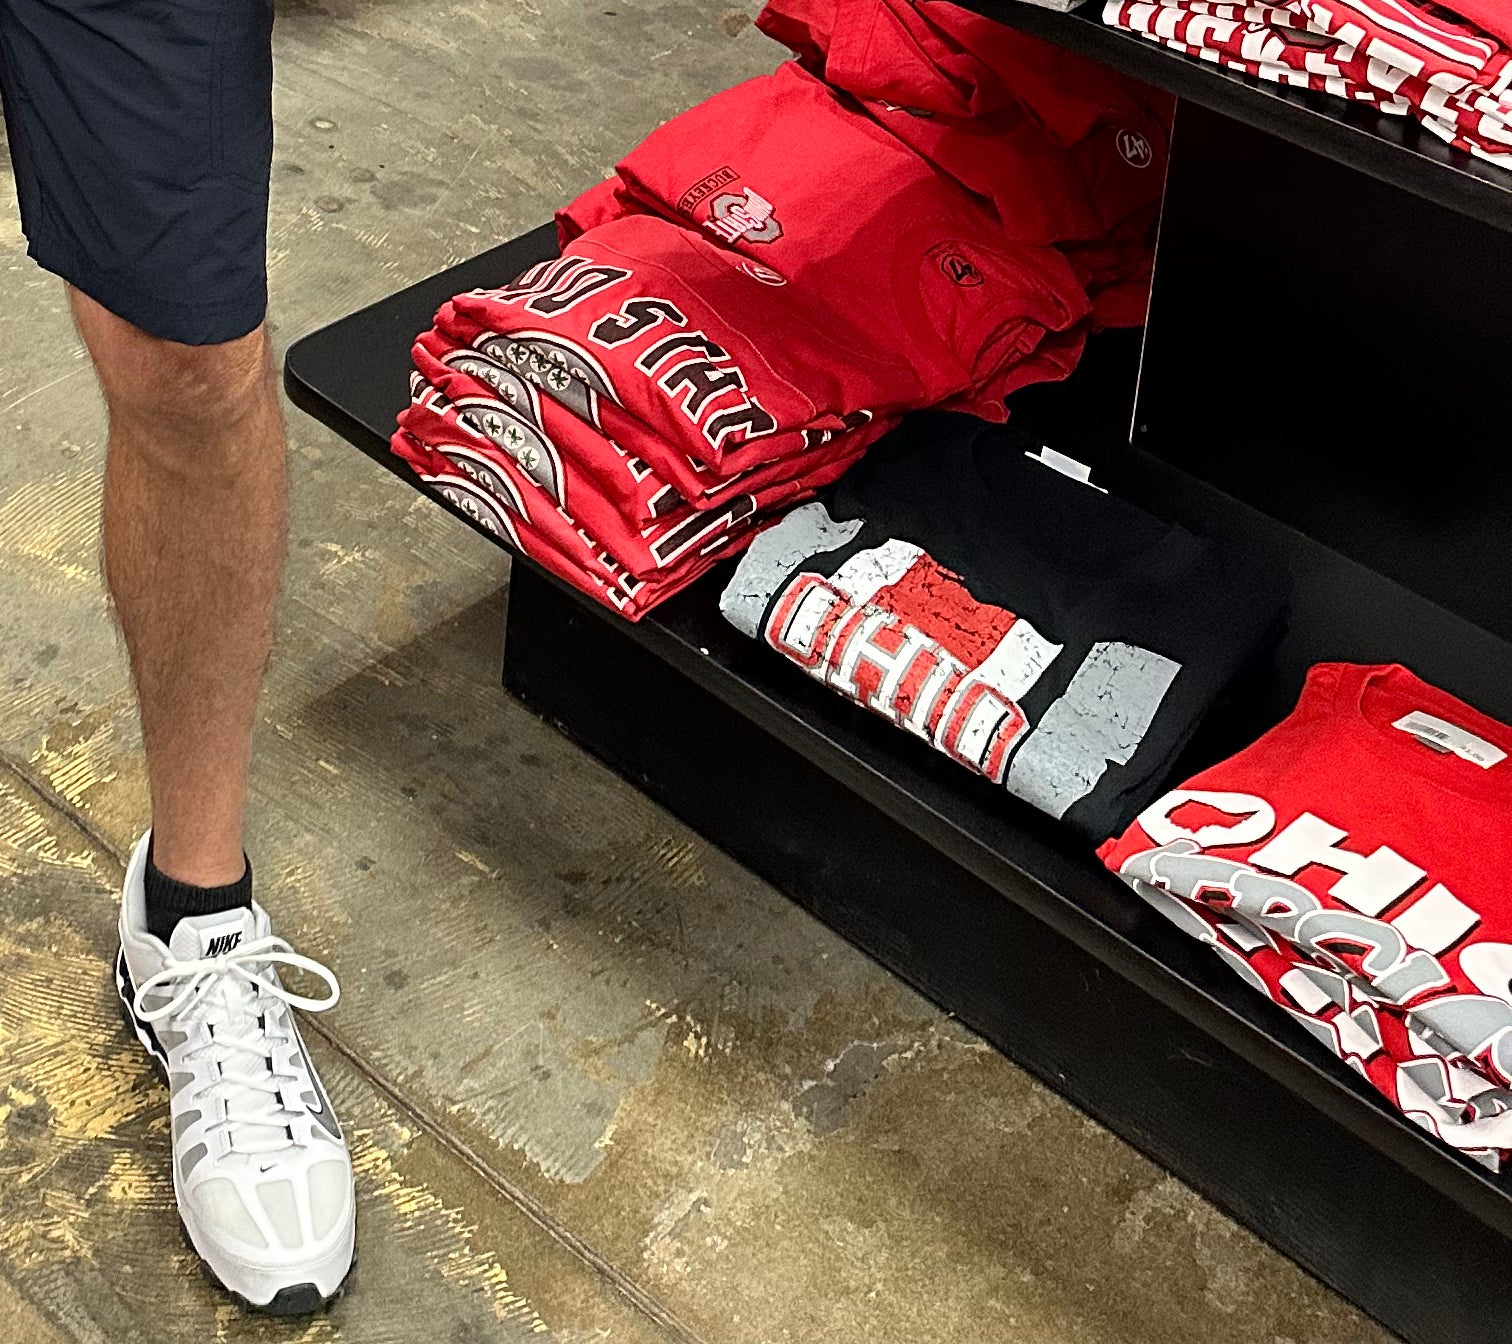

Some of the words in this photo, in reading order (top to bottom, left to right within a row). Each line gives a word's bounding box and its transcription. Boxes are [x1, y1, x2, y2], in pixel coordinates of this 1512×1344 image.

[587, 296, 779, 451] STAT
[762, 570, 1032, 786] OHIO
[205, 930, 243, 958] NIKE
